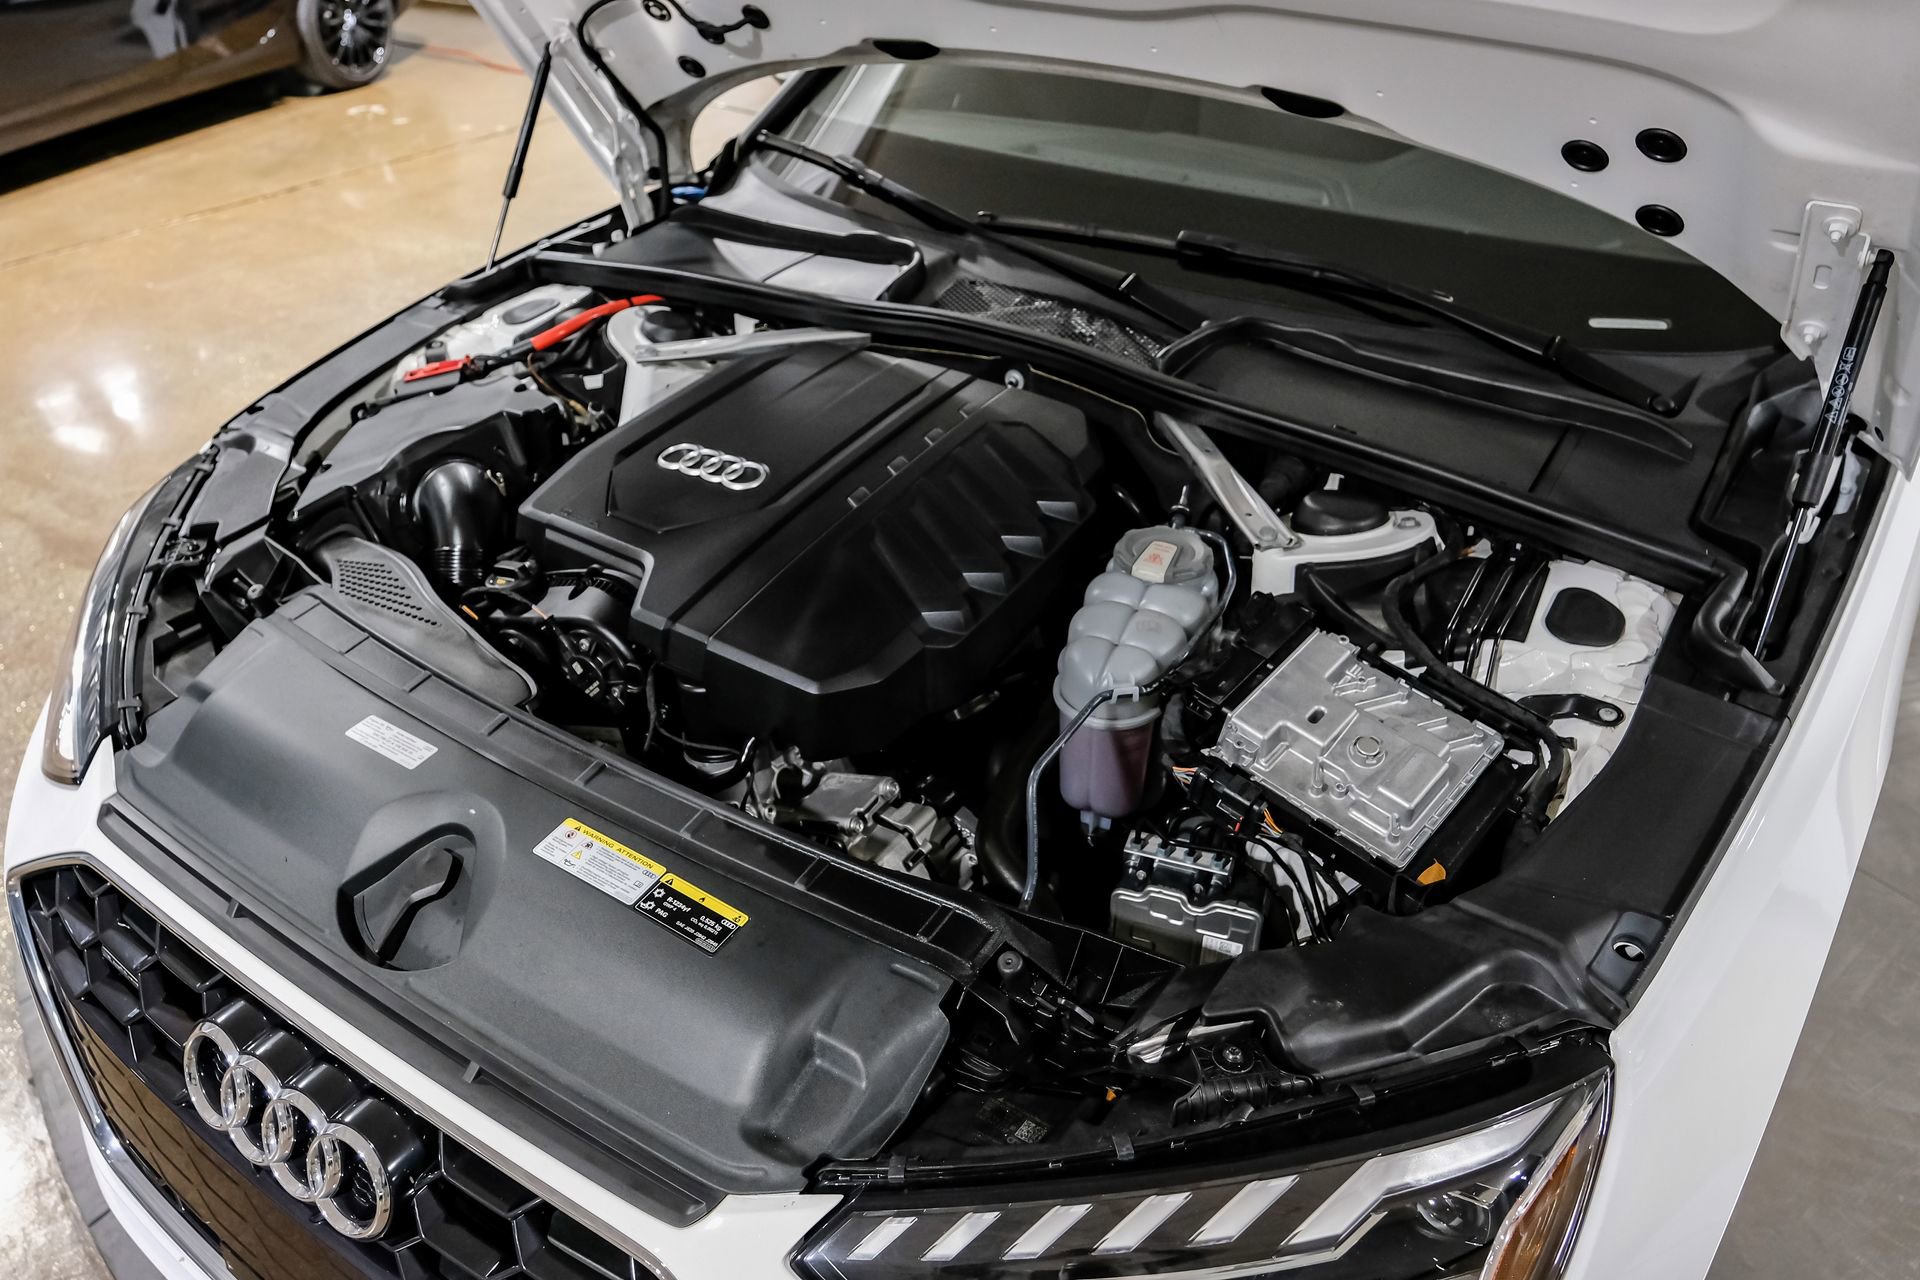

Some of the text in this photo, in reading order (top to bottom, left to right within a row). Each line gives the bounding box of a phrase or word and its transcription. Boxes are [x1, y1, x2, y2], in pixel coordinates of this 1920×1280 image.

[582, 829, 615, 849] WARNING
[616, 847, 654, 869] ATTENTION
[654, 907, 669, 918] PAG
